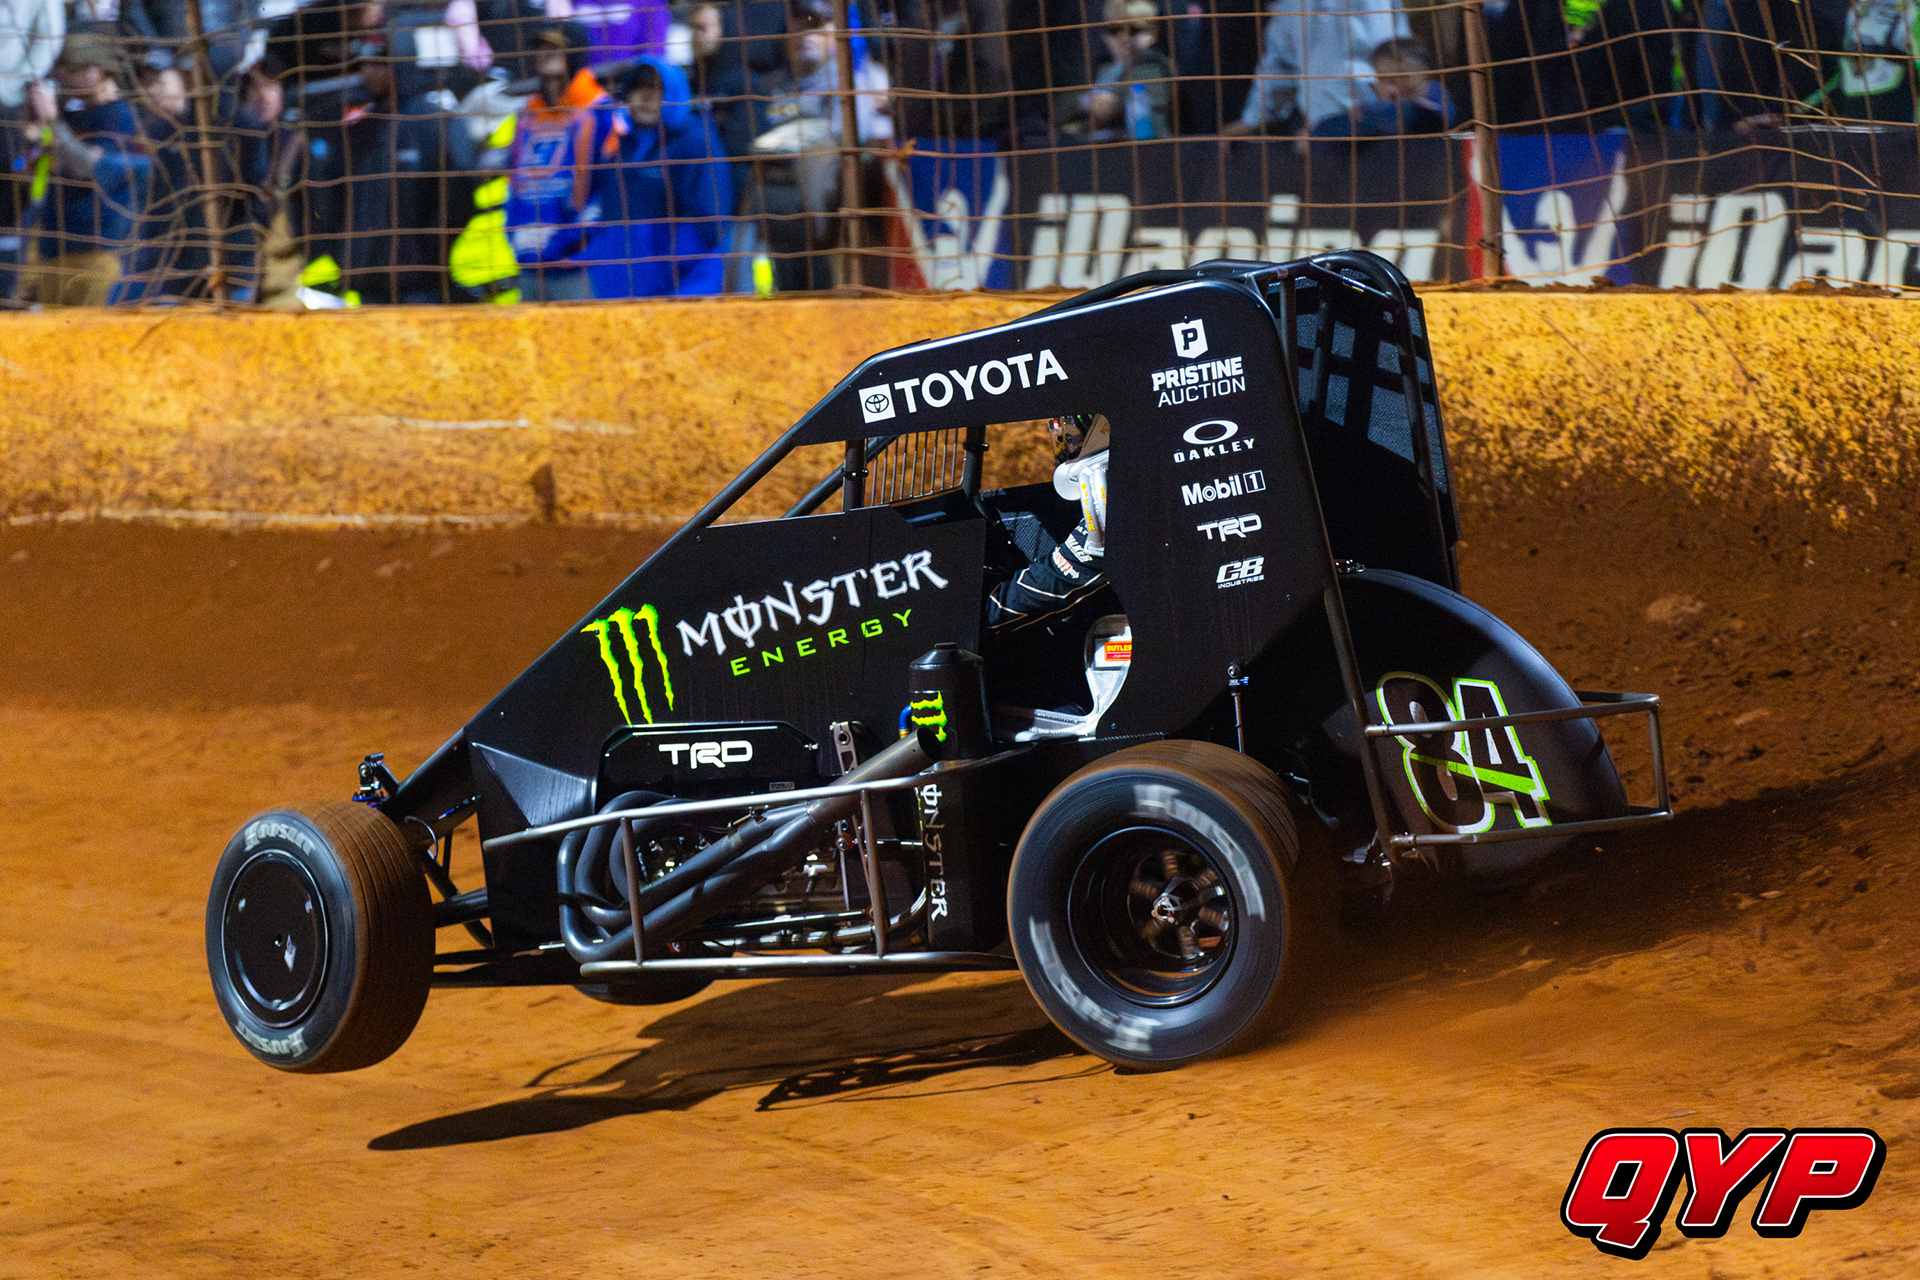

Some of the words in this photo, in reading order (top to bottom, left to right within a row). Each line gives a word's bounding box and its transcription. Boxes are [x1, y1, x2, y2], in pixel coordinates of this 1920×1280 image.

[1181, 328, 1198, 351] P
[894, 349, 1068, 413] TOYOTA
[1151, 356, 1243, 391] PRISTINE
[1158, 376, 1246, 408] AUCTION
[1173, 438, 1255, 463] OAKLEY
[1181, 475, 1243, 506] Mobil
[1196, 513, 1262, 542] TRD
[1218, 575, 1264, 589] INDUSTRIES
[675, 549, 948, 657] MONSTER
[730, 608, 912, 676] ENERGY
[658, 740, 753, 769] TRD
[1376, 671, 1552, 834] 84
[920, 783, 948, 921] ONSTER
